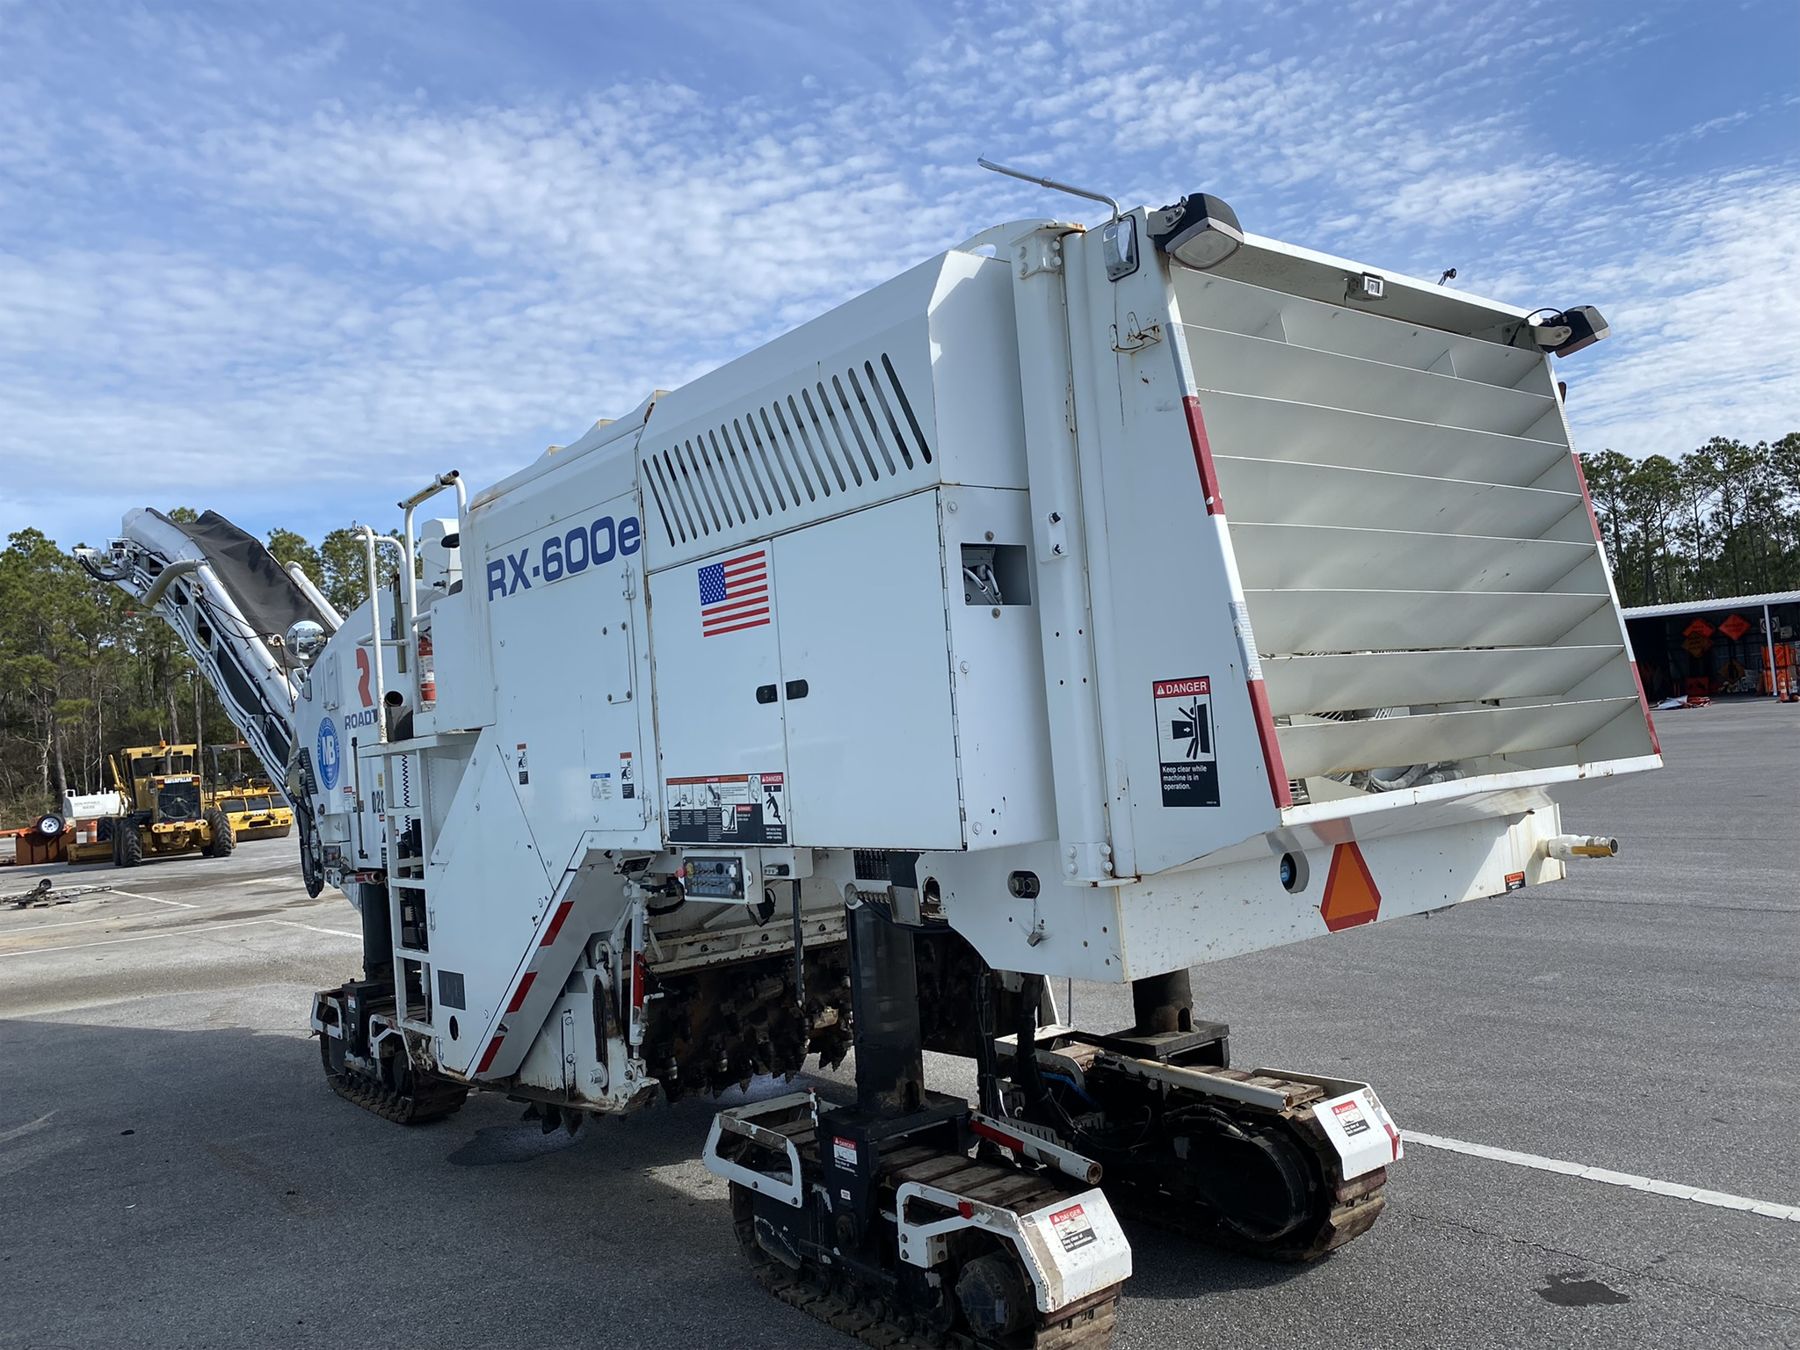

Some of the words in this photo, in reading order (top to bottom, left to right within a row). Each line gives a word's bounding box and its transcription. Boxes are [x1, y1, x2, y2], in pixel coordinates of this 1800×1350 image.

[487, 516, 641, 602] RX-600e
[1166, 681, 1207, 695] DANGER
[345, 709, 378, 730] ROADT
[1162, 766, 1176, 774] Keep
[1177, 765, 1191, 773] clear
[1164, 783, 1191, 791] operation.
